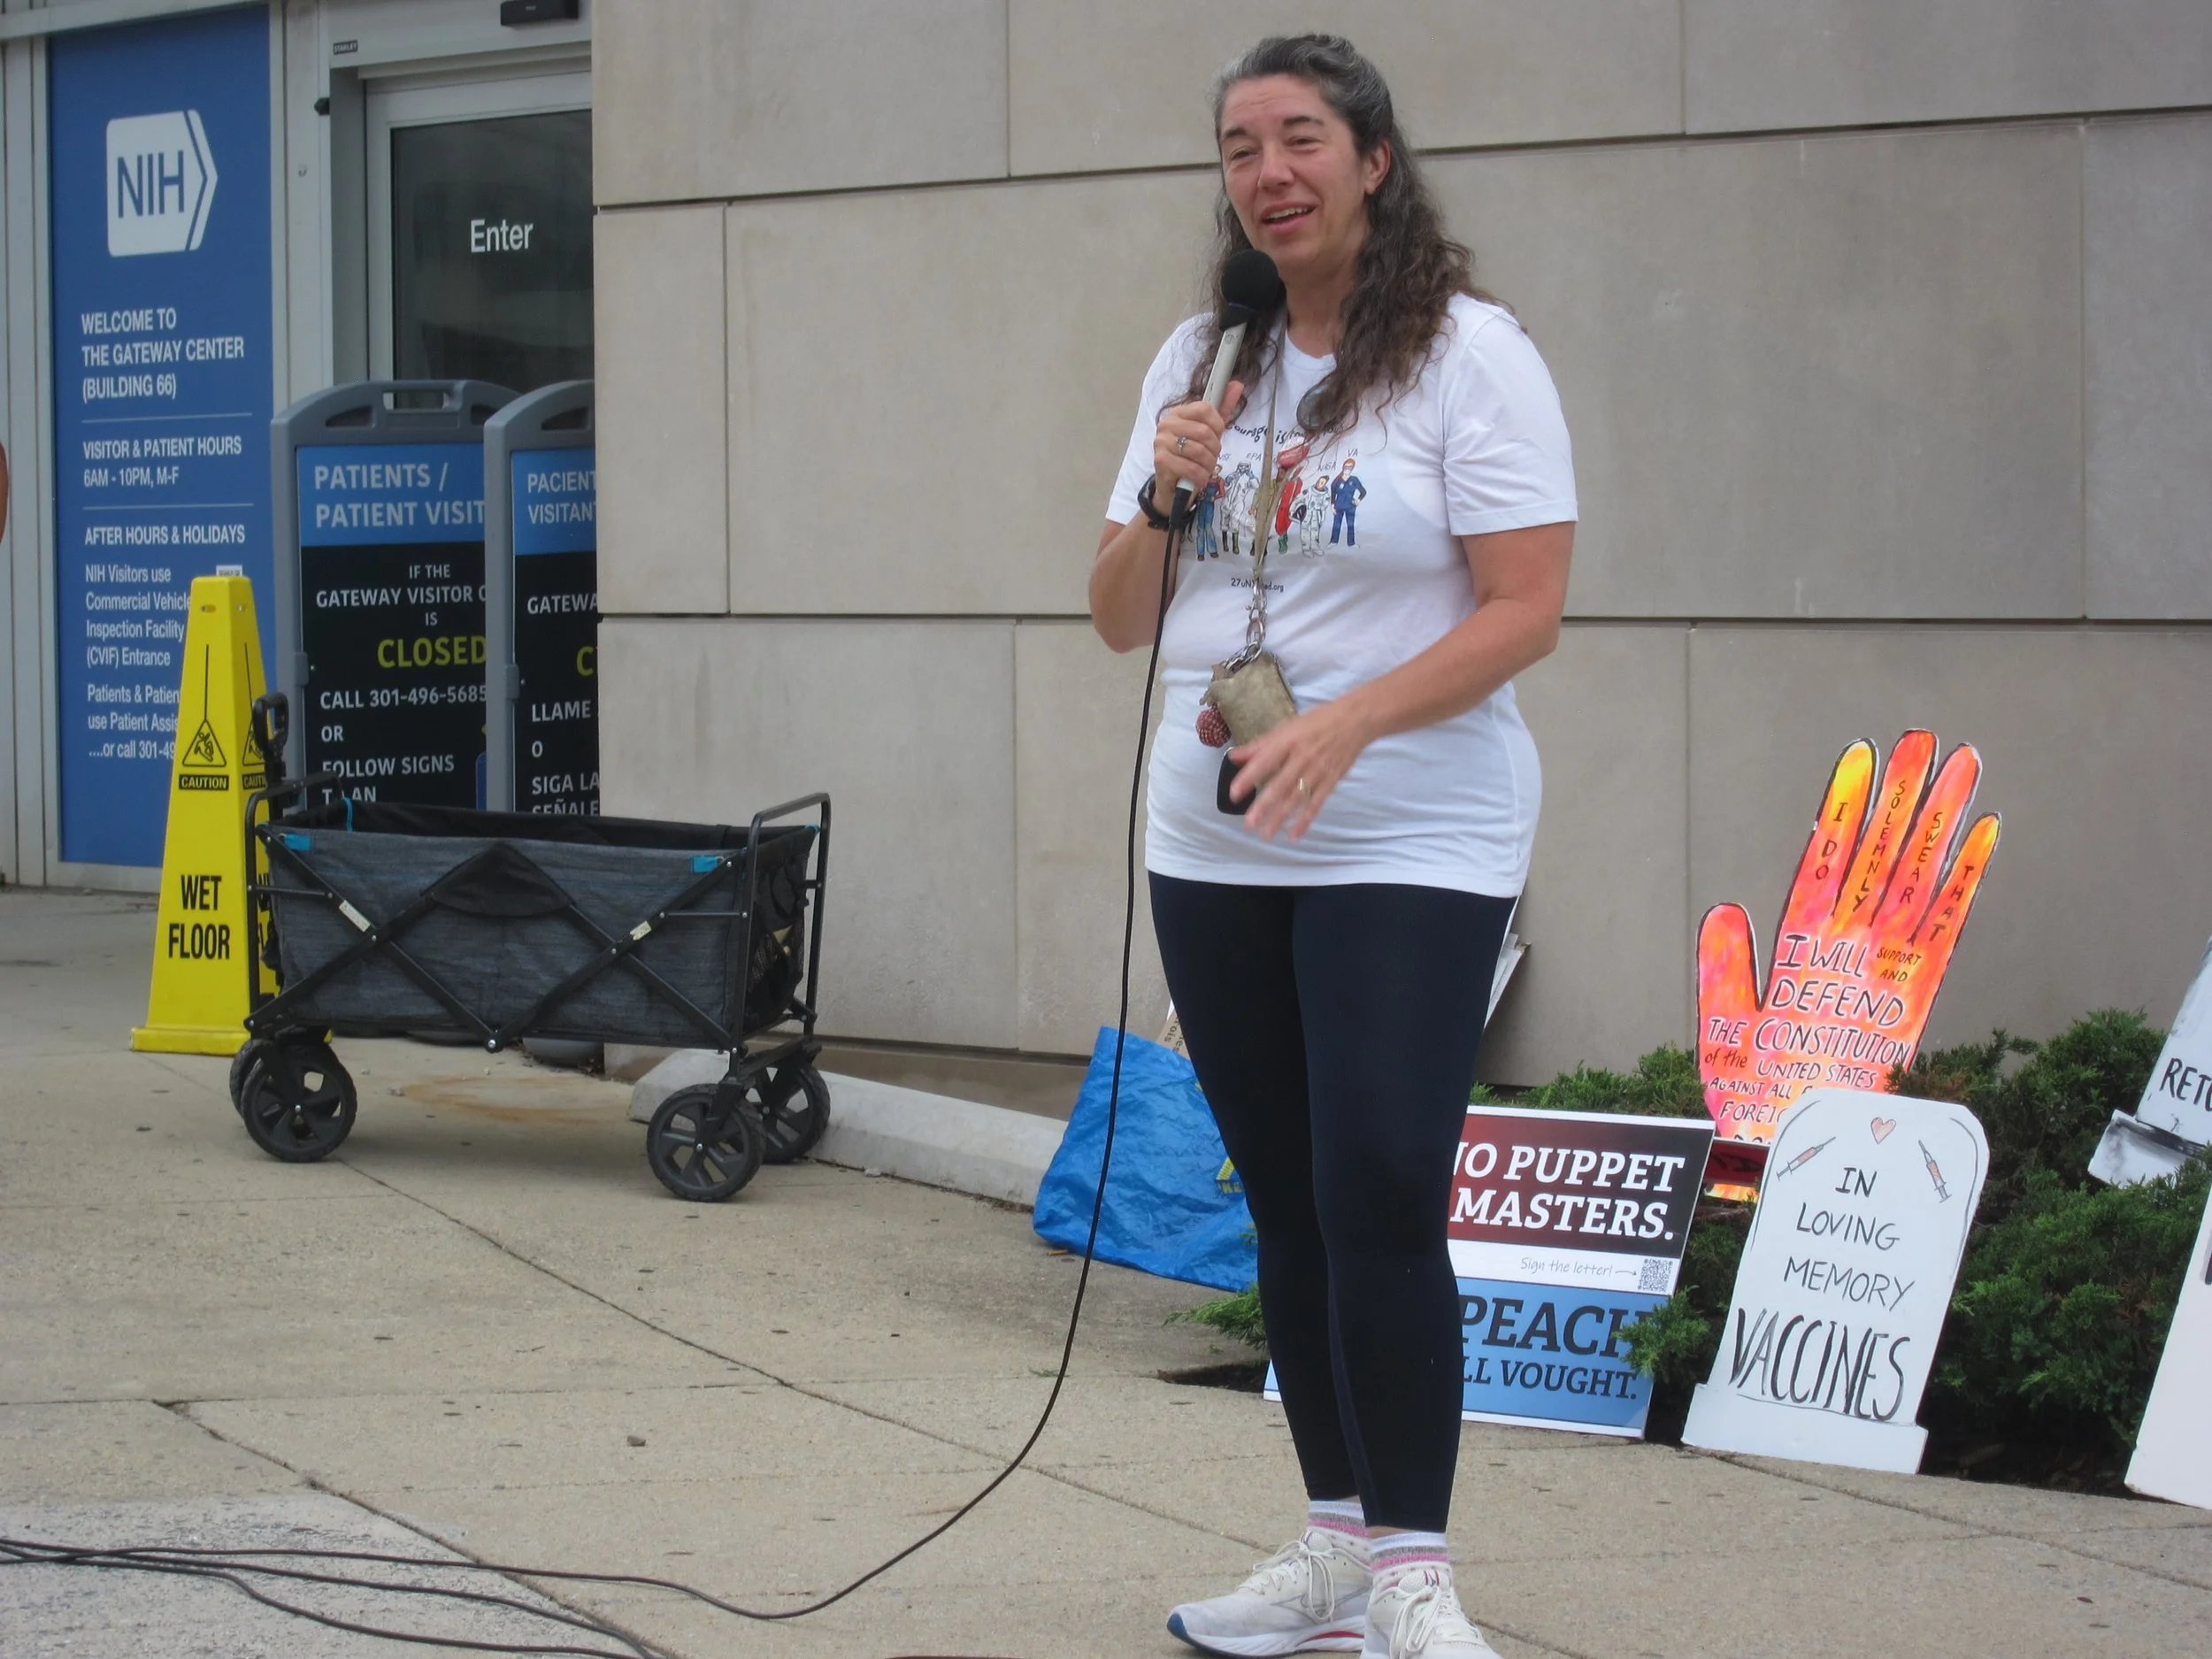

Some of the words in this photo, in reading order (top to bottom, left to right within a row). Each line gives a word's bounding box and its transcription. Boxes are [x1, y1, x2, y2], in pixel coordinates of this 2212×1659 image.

[118, 150, 185, 219] NIH
[471, 219, 534, 253] Enter
[81, 309, 153, 334] WELCOME
[157, 307, 176, 330] TO
[81, 344, 109, 367] THE
[112, 340, 181, 365] GATEWAY
[185, 335, 244, 361] CENTER
[82, 373, 153, 403] (BUILDING
[157, 373, 176, 400] 66)
[83, 440, 129, 460] VISITOR
[133, 439, 141, 458] &
[144, 438, 195, 457] PATIENT
[197, 435, 242, 456] HOURS
[83, 468, 108, 487] 6AM
[119, 467, 153, 488] 10PM,
[157, 466, 179, 485] M-F
[314, 464, 431, 490] PATIENTS
[439, 462, 449, 491] /
[527, 471, 596, 493] PACIENT
[316, 502, 418, 528] PATIENT
[425, 500, 485, 525] VISIT
[528, 502, 596, 524] VISITAN
[85, 526, 122, 545] AFTER
[126, 526, 168, 545] HOURS
[171, 526, 180, 544] &
[183, 524, 245, 544] HOLIDAYS
[86, 564, 105, 582] NIH
[108, 564, 149, 583] Visitors
[151, 568, 171, 583] use
[409, 565, 420, 579] IF
[425, 564, 450, 578] THE
[86, 592, 150, 611] Commercial
[316, 588, 402, 608] GATEWAY
[407, 585, 472, 604] VISITOR
[527, 593, 598, 614] GATEWA
[86, 619, 142, 641] Inspection
[145, 619, 185, 642] Facility
[426, 612, 438, 626] IS
[87, 647, 119, 669] (CVIF)
[122, 648, 171, 665] Entrance
[378, 635, 486, 668] CLOSED
[88, 683, 131, 703] Patients
[134, 684, 142, 703] &
[145, 685, 180, 704] Patien
[320, 690, 365, 709] CALL
[369, 685, 487, 707] 301-496-5685
[88, 717, 107, 729] use
[111, 712, 148, 731] Patient
[152, 713, 178, 732] Assis
[532, 701, 591, 722] LLAME
[321, 726, 343, 742] OR
[117, 741, 135, 758] call
[139, 741, 176, 759] 301-49
[532, 740, 542, 758] O
[322, 757, 396, 778] FOLLOW
[401, 755, 455, 774] SIGNS
[181, 777, 227, 788] CAUTION
[532, 774, 573, 795] SIGA
[533, 798, 599, 815] SEÑALE
[1833, 802, 1847, 822] I
[1852, 780, 1906, 912] SOLEMNLY
[1900, 811, 1943, 903] SWEAR
[1816, 839, 1837, 880] DO
[180, 874, 222, 910] WET
[1929, 865, 1975, 941] THAT
[168, 923, 230, 959] FLOOR
[1778, 933, 1808, 968] I
[1809, 940, 1867, 978] WILL
[1877, 947, 1922, 966] SUPPORT
[1880, 969, 1908, 982] AND
[1771, 979, 1904, 1026] DEFEND
[1708, 1018, 1747, 1045] THE
[1755, 1018, 1913, 1065] CONSTITUTION
[1704, 1048, 1722, 1068] of
[1724, 1049, 1748, 1069] the
[1758, 1059, 1821, 1080] UNITED
[1826, 1064, 1878, 1088] STATES
[1709, 1077, 1765, 1096] AGAINST
[1769, 1082, 1792, 1100] ALL
[1503, 1145, 1686, 1193] PUPPET
[1835, 1167, 1877, 1197] IN
[1449, 1187, 1674, 1240] MASTERS.
[1796, 1202, 1900, 1250] LOVING
[1520, 1256, 1546, 1273] Sign
[1548, 1259, 1570, 1273] the
[1573, 1261, 1613, 1277] letter!
[1784, 1256, 1916, 1311] MEMORY
[1728, 1308, 1911, 1421] VACCINES
[1501, 1359, 1637, 1400] VOUGHT.
